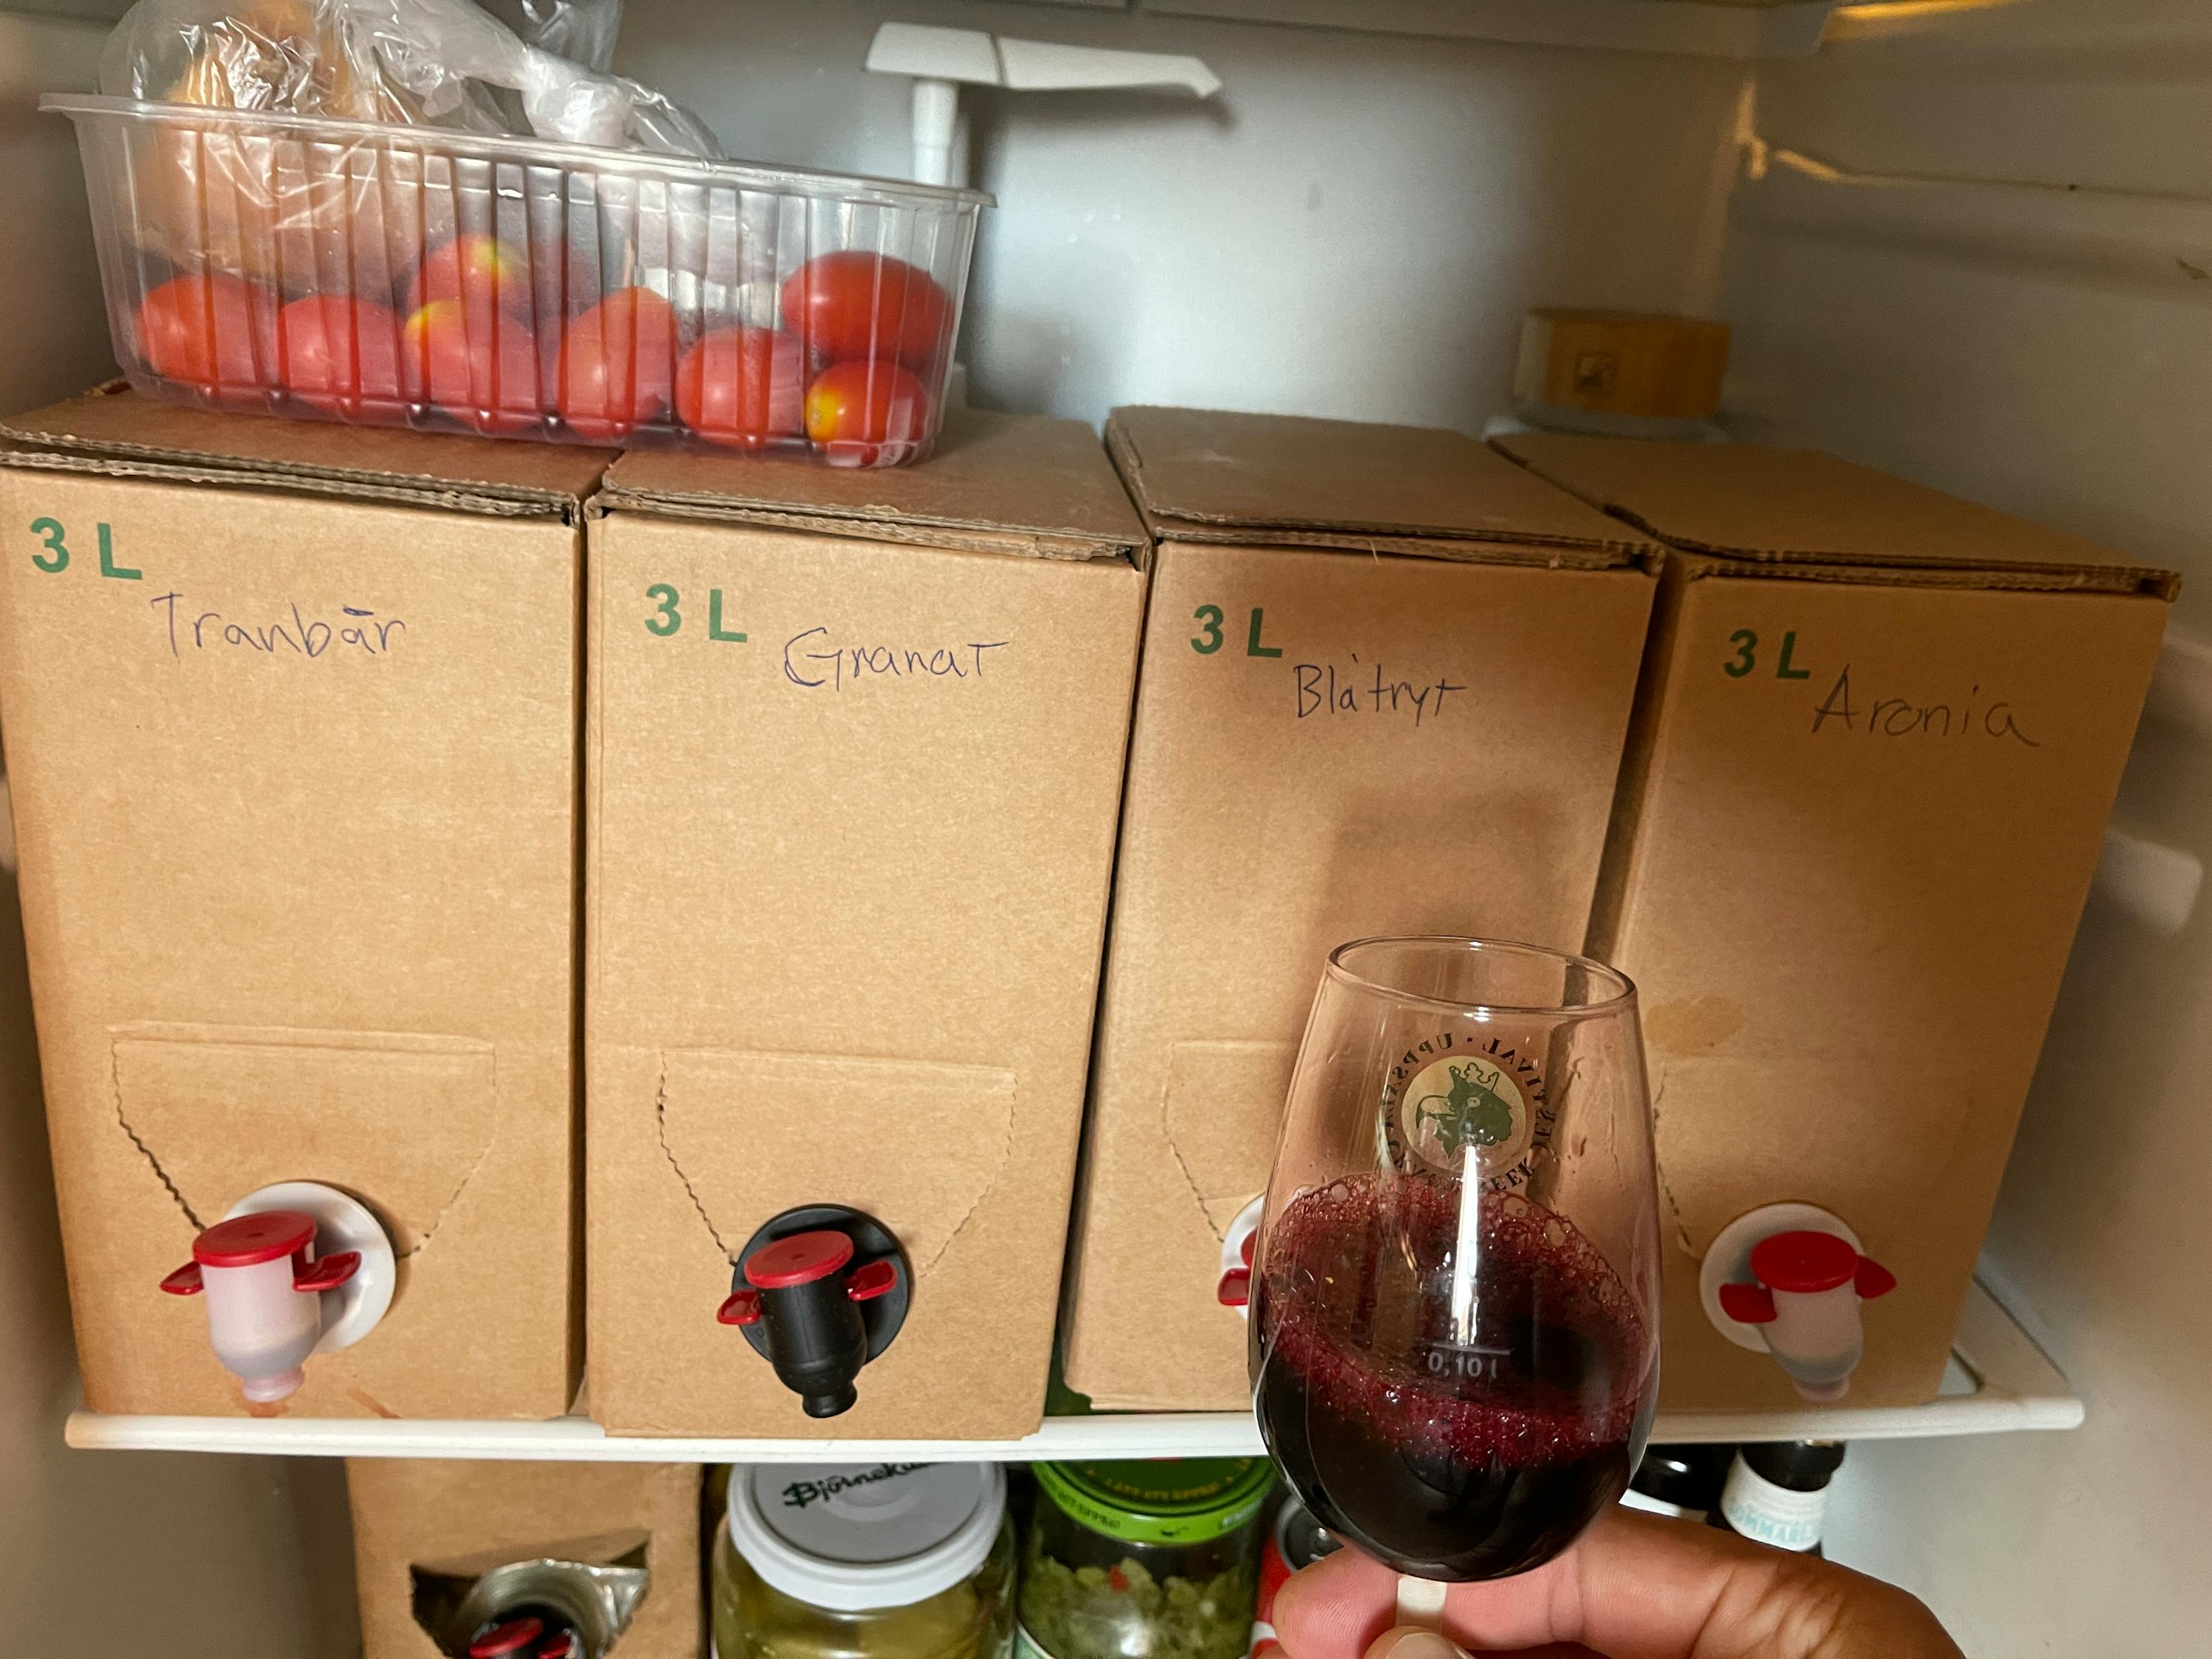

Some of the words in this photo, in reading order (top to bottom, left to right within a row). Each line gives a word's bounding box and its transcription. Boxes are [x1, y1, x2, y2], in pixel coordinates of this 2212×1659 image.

[29, 517, 70, 573] 3
[97, 522, 143, 580] L
[150, 591, 406, 658] Tranbär
[644, 582, 682, 637] 3
[709, 588, 748, 643] L
[1190, 604, 1224, 655] 3
[1246, 607, 1283, 658] L
[1722, 628, 1759, 678] 3
[1775, 630, 1811, 680] L
[1812, 664, 2040, 748] Aronia
[1427, 1352, 1483, 1378] 0,10
